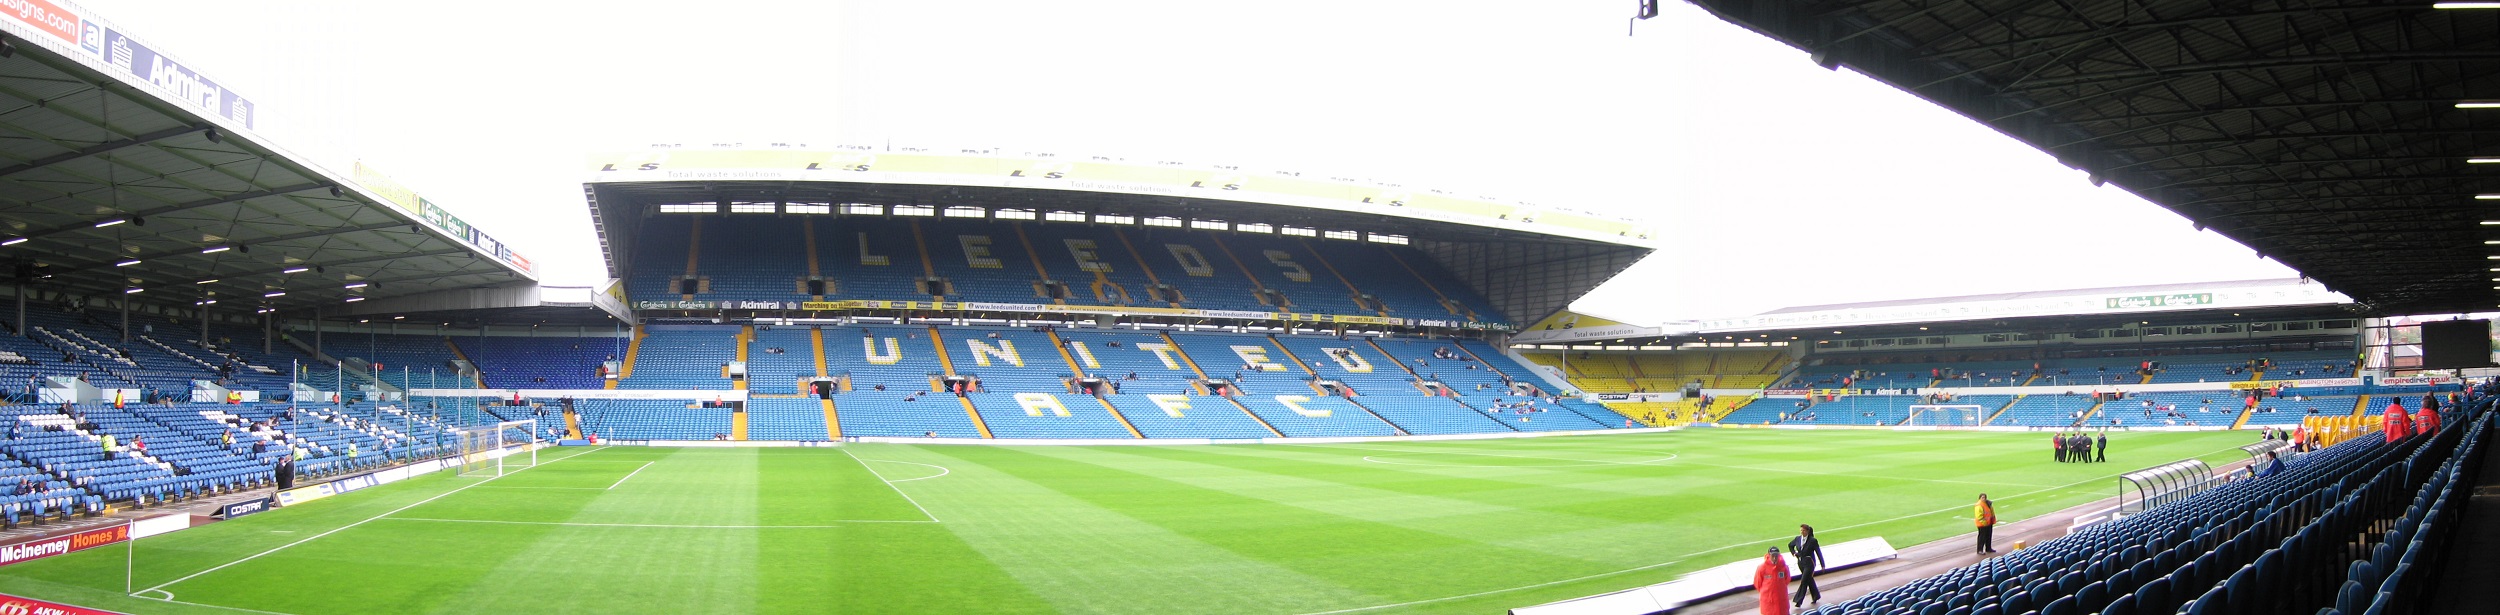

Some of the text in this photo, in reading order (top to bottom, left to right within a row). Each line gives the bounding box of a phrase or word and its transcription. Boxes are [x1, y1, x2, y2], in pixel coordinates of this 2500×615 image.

[150, 54, 220, 114] Admiral
[732, 171, 783, 179] solutions
[1070, 180, 1173, 194] Total waste solutions
[2118, 296, 2151, 308] Carlsberg
[2163, 293, 2198, 306] Carlsberg
[640, 300, 667, 310] Carlsberg
[679, 300, 706, 310] Carlsberg
[740, 300, 780, 310] Admiral
[804, 302, 829, 311] Marching
[975, 303, 1037, 311] www.leedsunited.com
[1208, 311, 1264, 319] www.leedsunited.com
[1419, 319, 1447, 328] Admiral
[2384, 376, 2451, 385] empiredirectco.uk
[1876, 388, 1902, 396] Admiral
[0, 529, 113, 563] McInerney Homes
[34, 606, 65, 615] AKW
